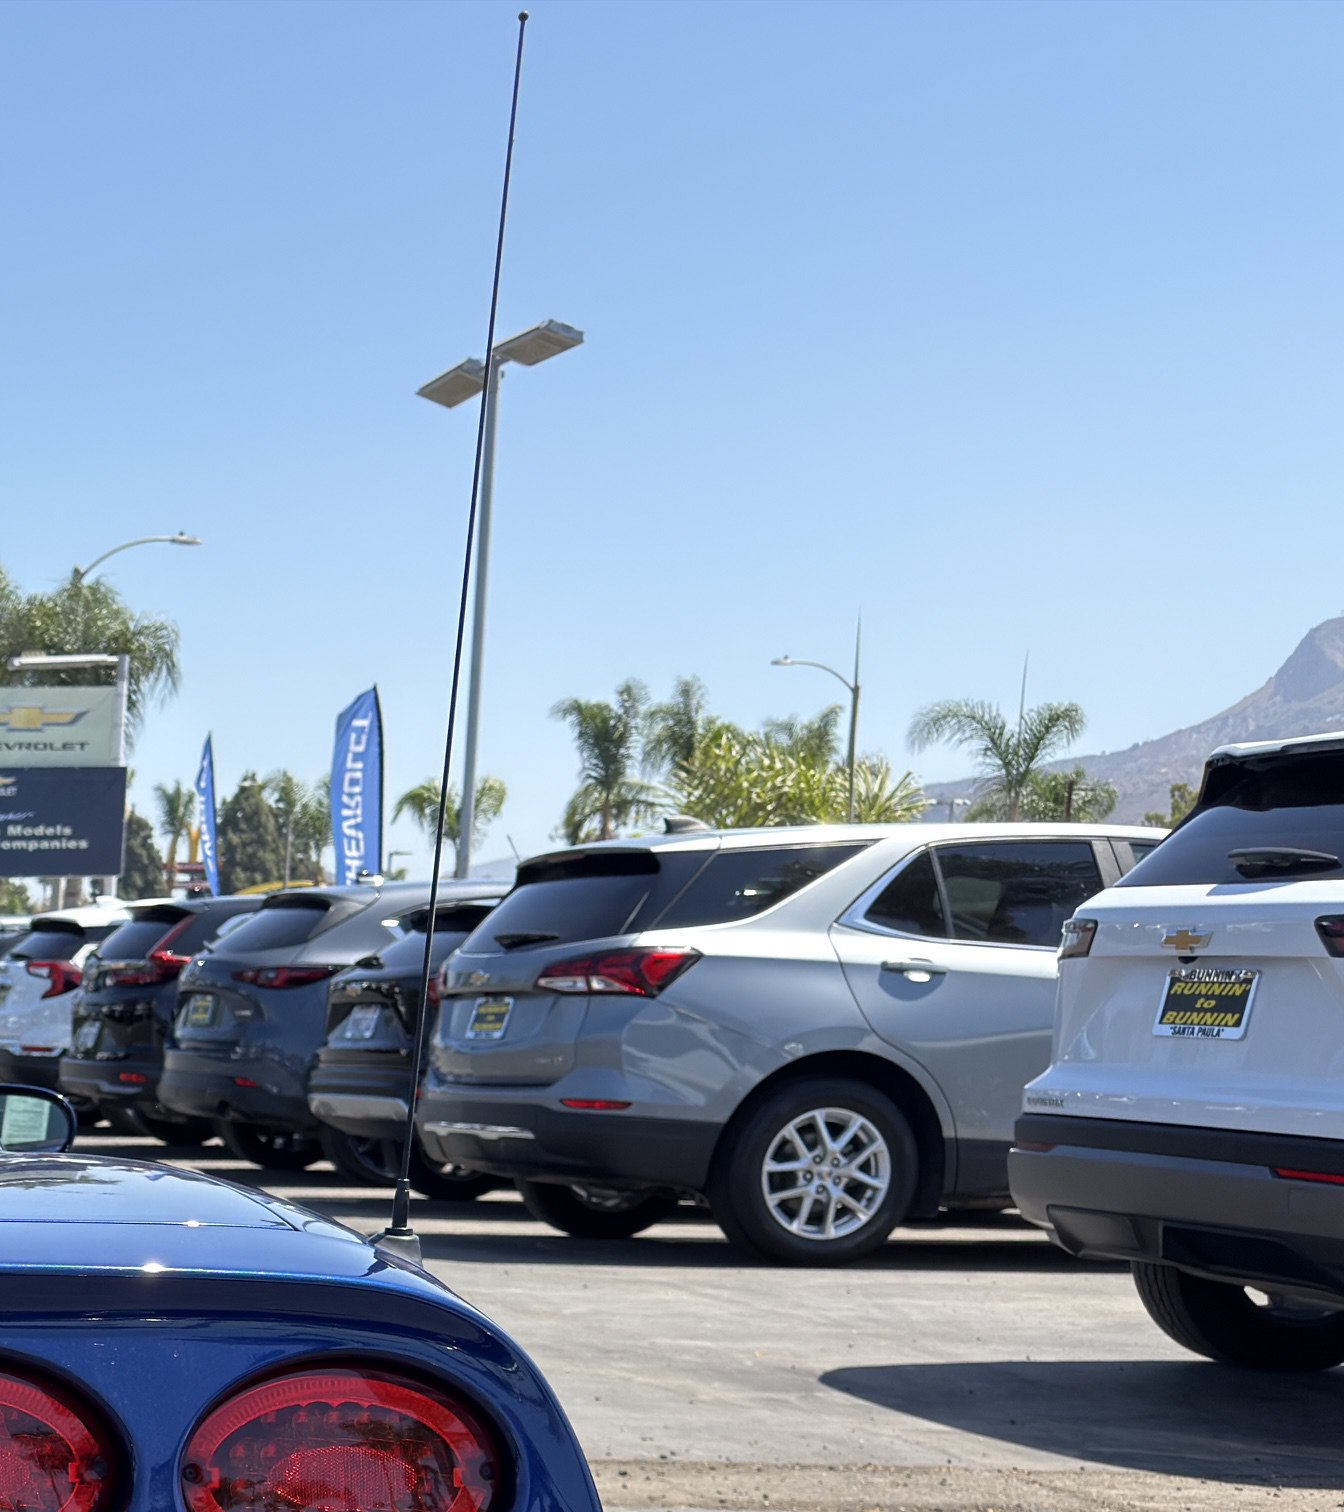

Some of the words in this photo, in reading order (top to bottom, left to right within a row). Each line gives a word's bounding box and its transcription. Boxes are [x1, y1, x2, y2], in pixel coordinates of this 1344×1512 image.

[7, 825, 73, 837] Models
[1190, 969, 1235, 982] BUNNIN
[1170, 982, 1251, 996] RUNNIN'
[1195, 997, 1216, 1008] to
[1162, 1011, 1240, 1026] BUNNIN
